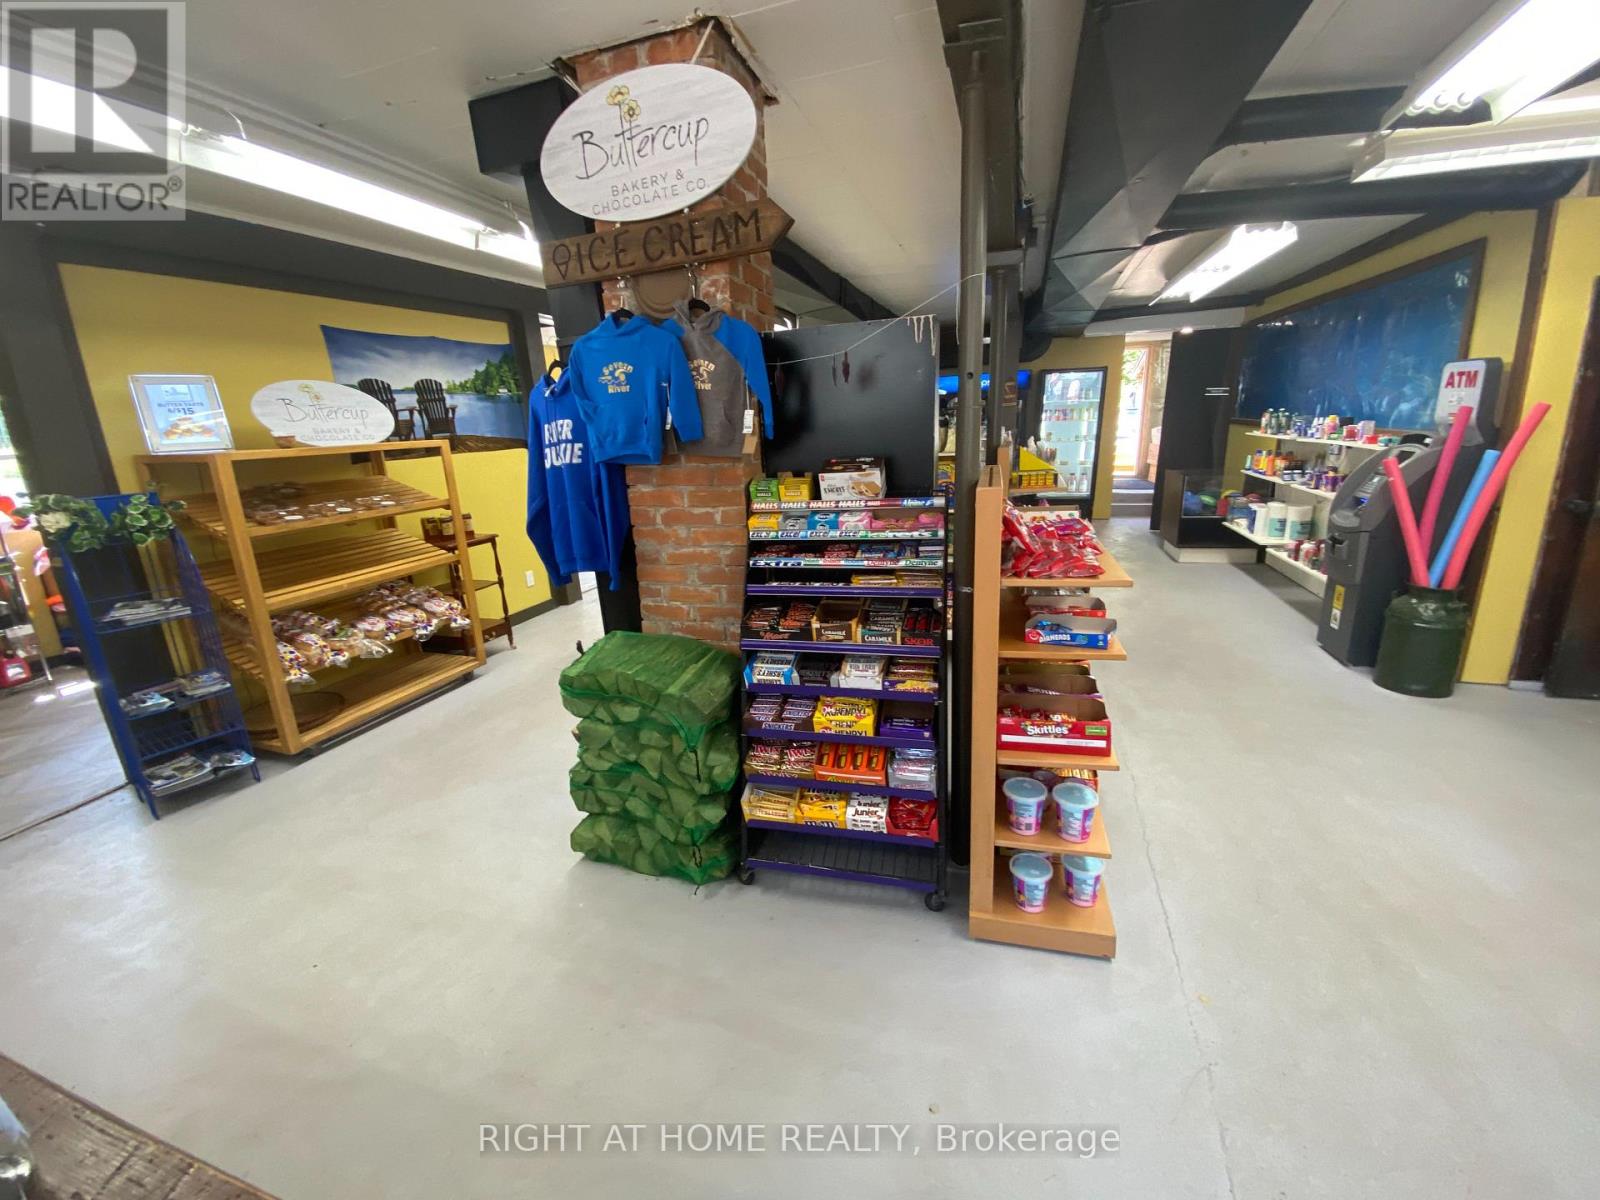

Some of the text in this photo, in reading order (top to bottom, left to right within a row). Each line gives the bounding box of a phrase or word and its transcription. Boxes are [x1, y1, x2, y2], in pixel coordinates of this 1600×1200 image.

[572, 117, 709, 180] Buttercup
[610, 168, 685, 198] BAKERY &
[591, 185, 680, 216] CHOCOLATE
[575, 207, 763, 275] ICE CREAM
[1444, 370, 1479, 388] ATM
[276, 398, 369, 428] Buttercup
[753, 502, 778, 510] HALLS
[781, 501, 806, 509] HALLS
[838, 500, 866, 508] HALLS
[905, 559, 939, 567] Dentyne
[865, 634, 892, 643] CARAMILK
[904, 637, 934, 645] SKOR
[762, 722, 795, 731] SNICKERS
[1026, 724, 1069, 735] Skittles
